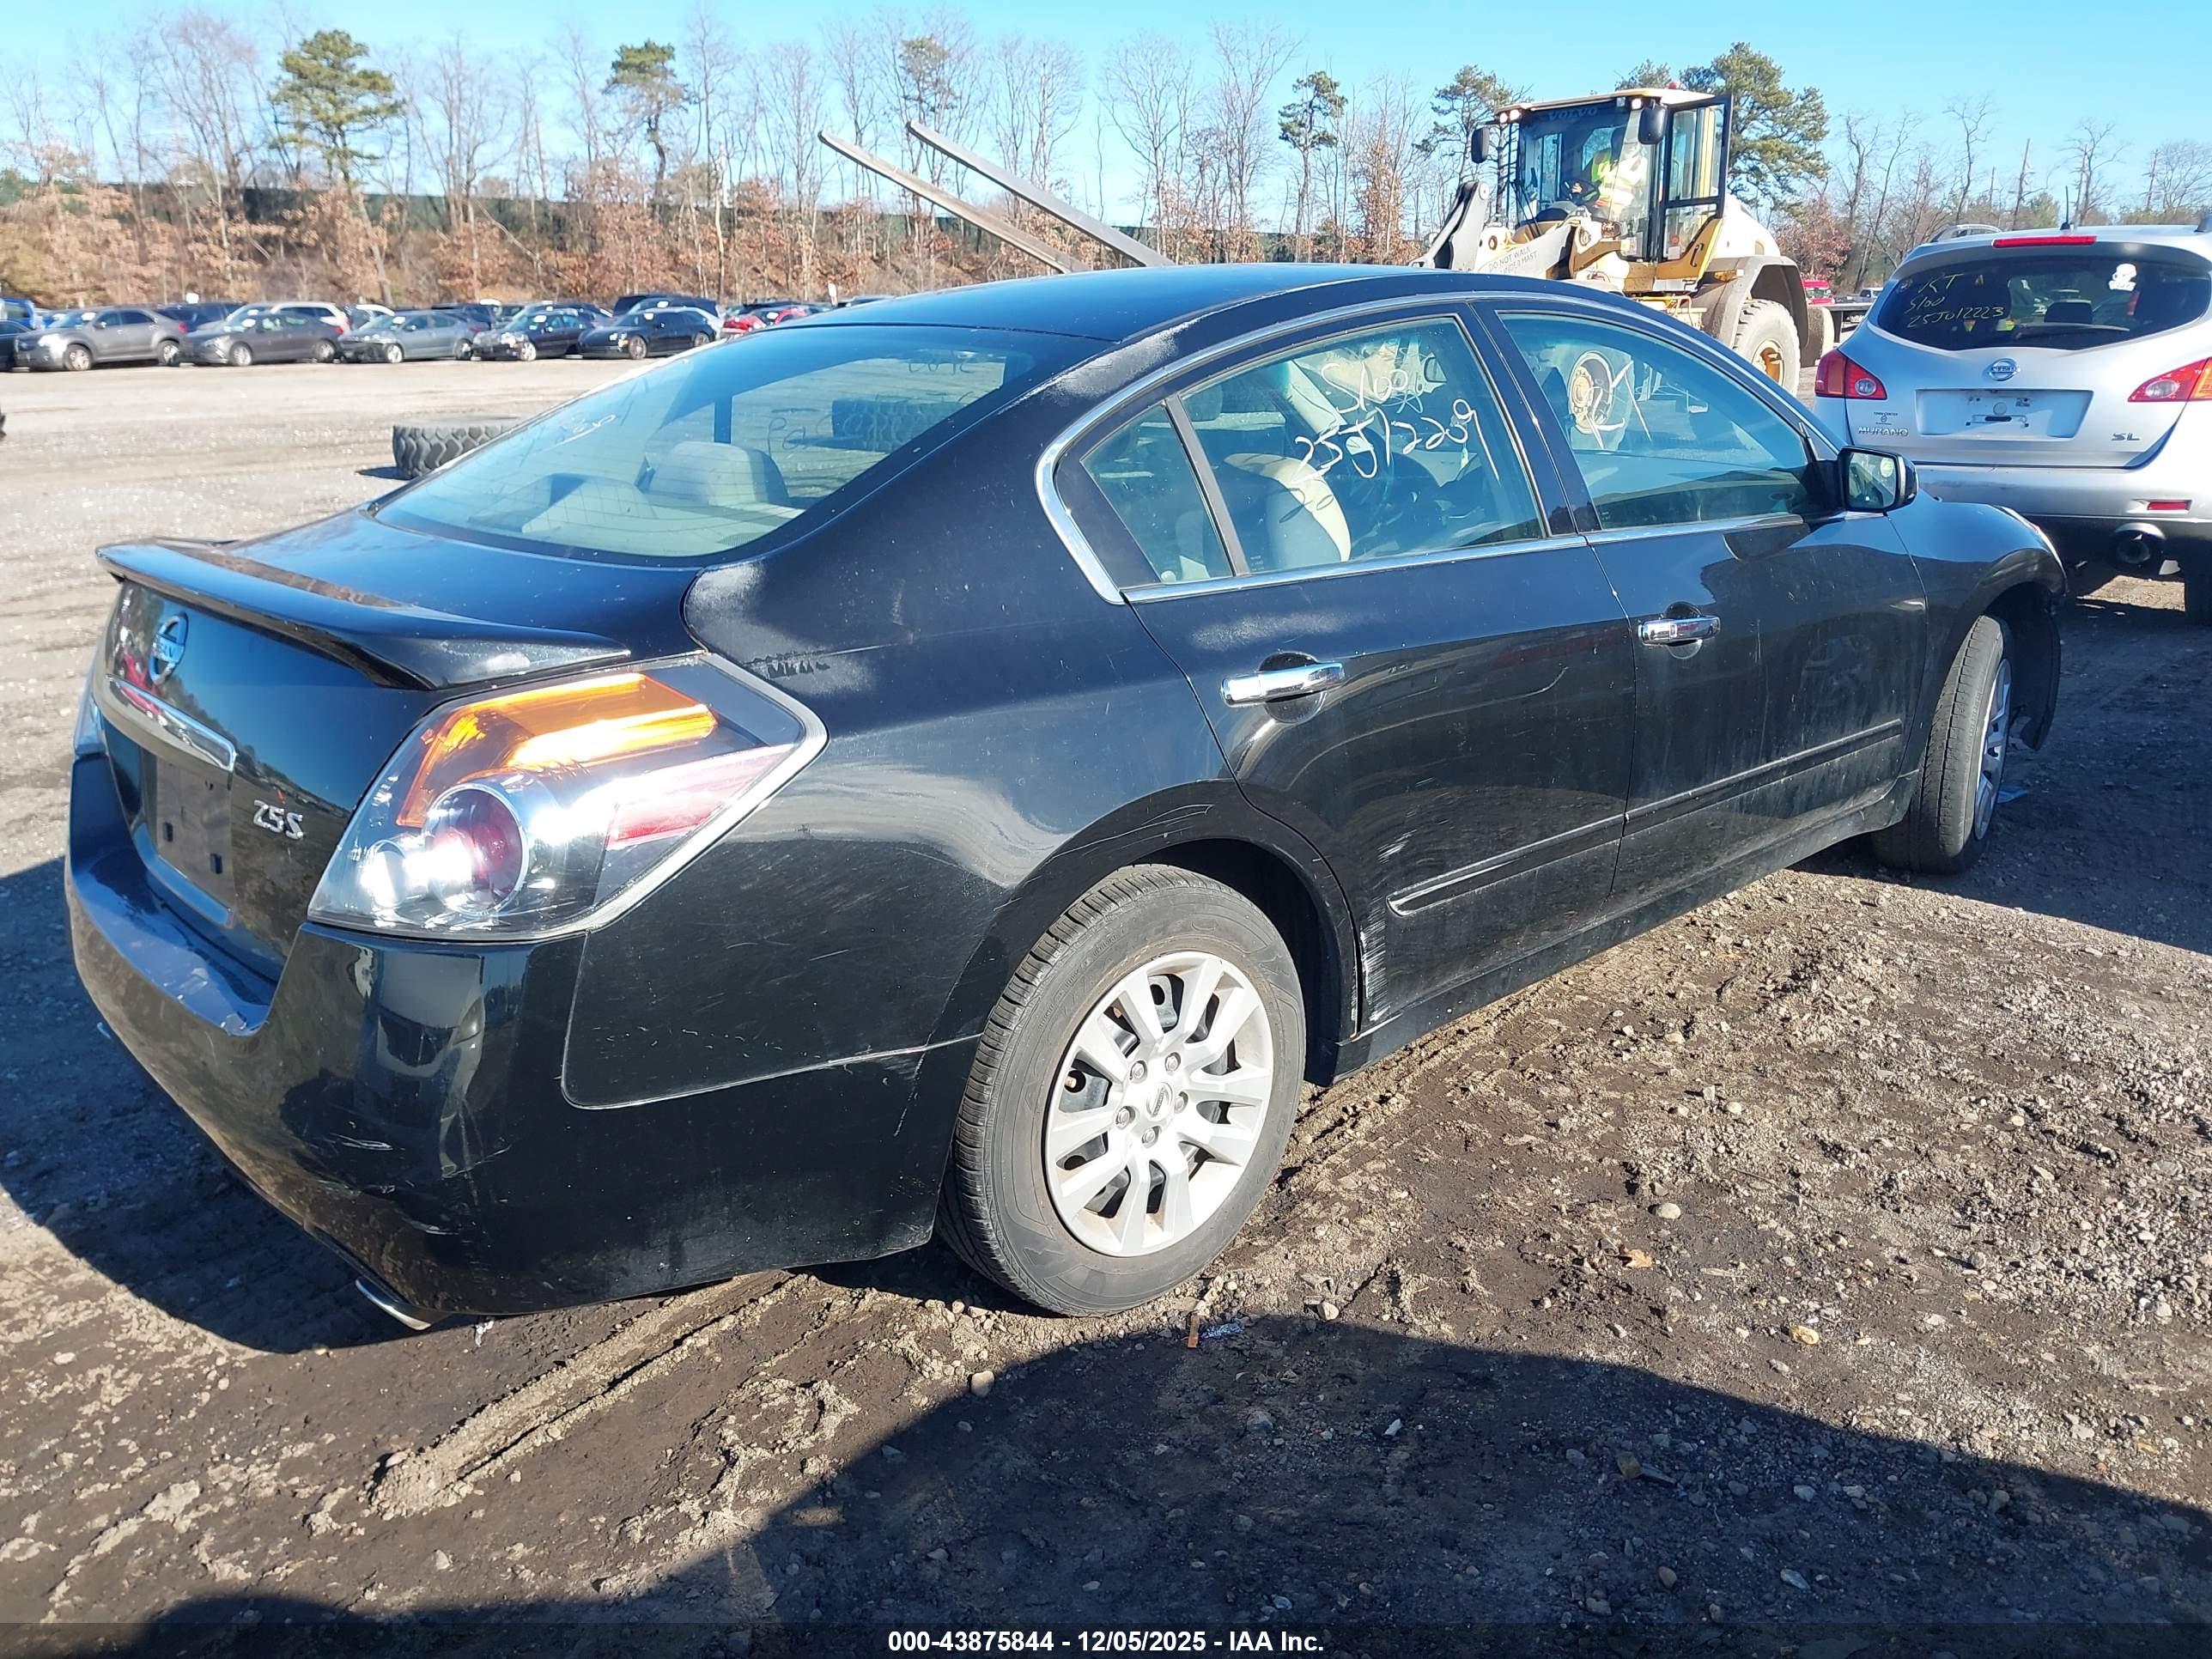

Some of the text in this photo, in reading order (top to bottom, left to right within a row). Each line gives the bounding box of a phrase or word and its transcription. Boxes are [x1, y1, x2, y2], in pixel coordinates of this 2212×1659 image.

[1548, 106, 1598, 120] VOLVO
[1488, 246, 1531, 272] DO NOT WALK
[1522, 250, 1537, 265] MAST
[1859, 427, 1909, 436] MURANO
[2111, 432, 2141, 441] SL
